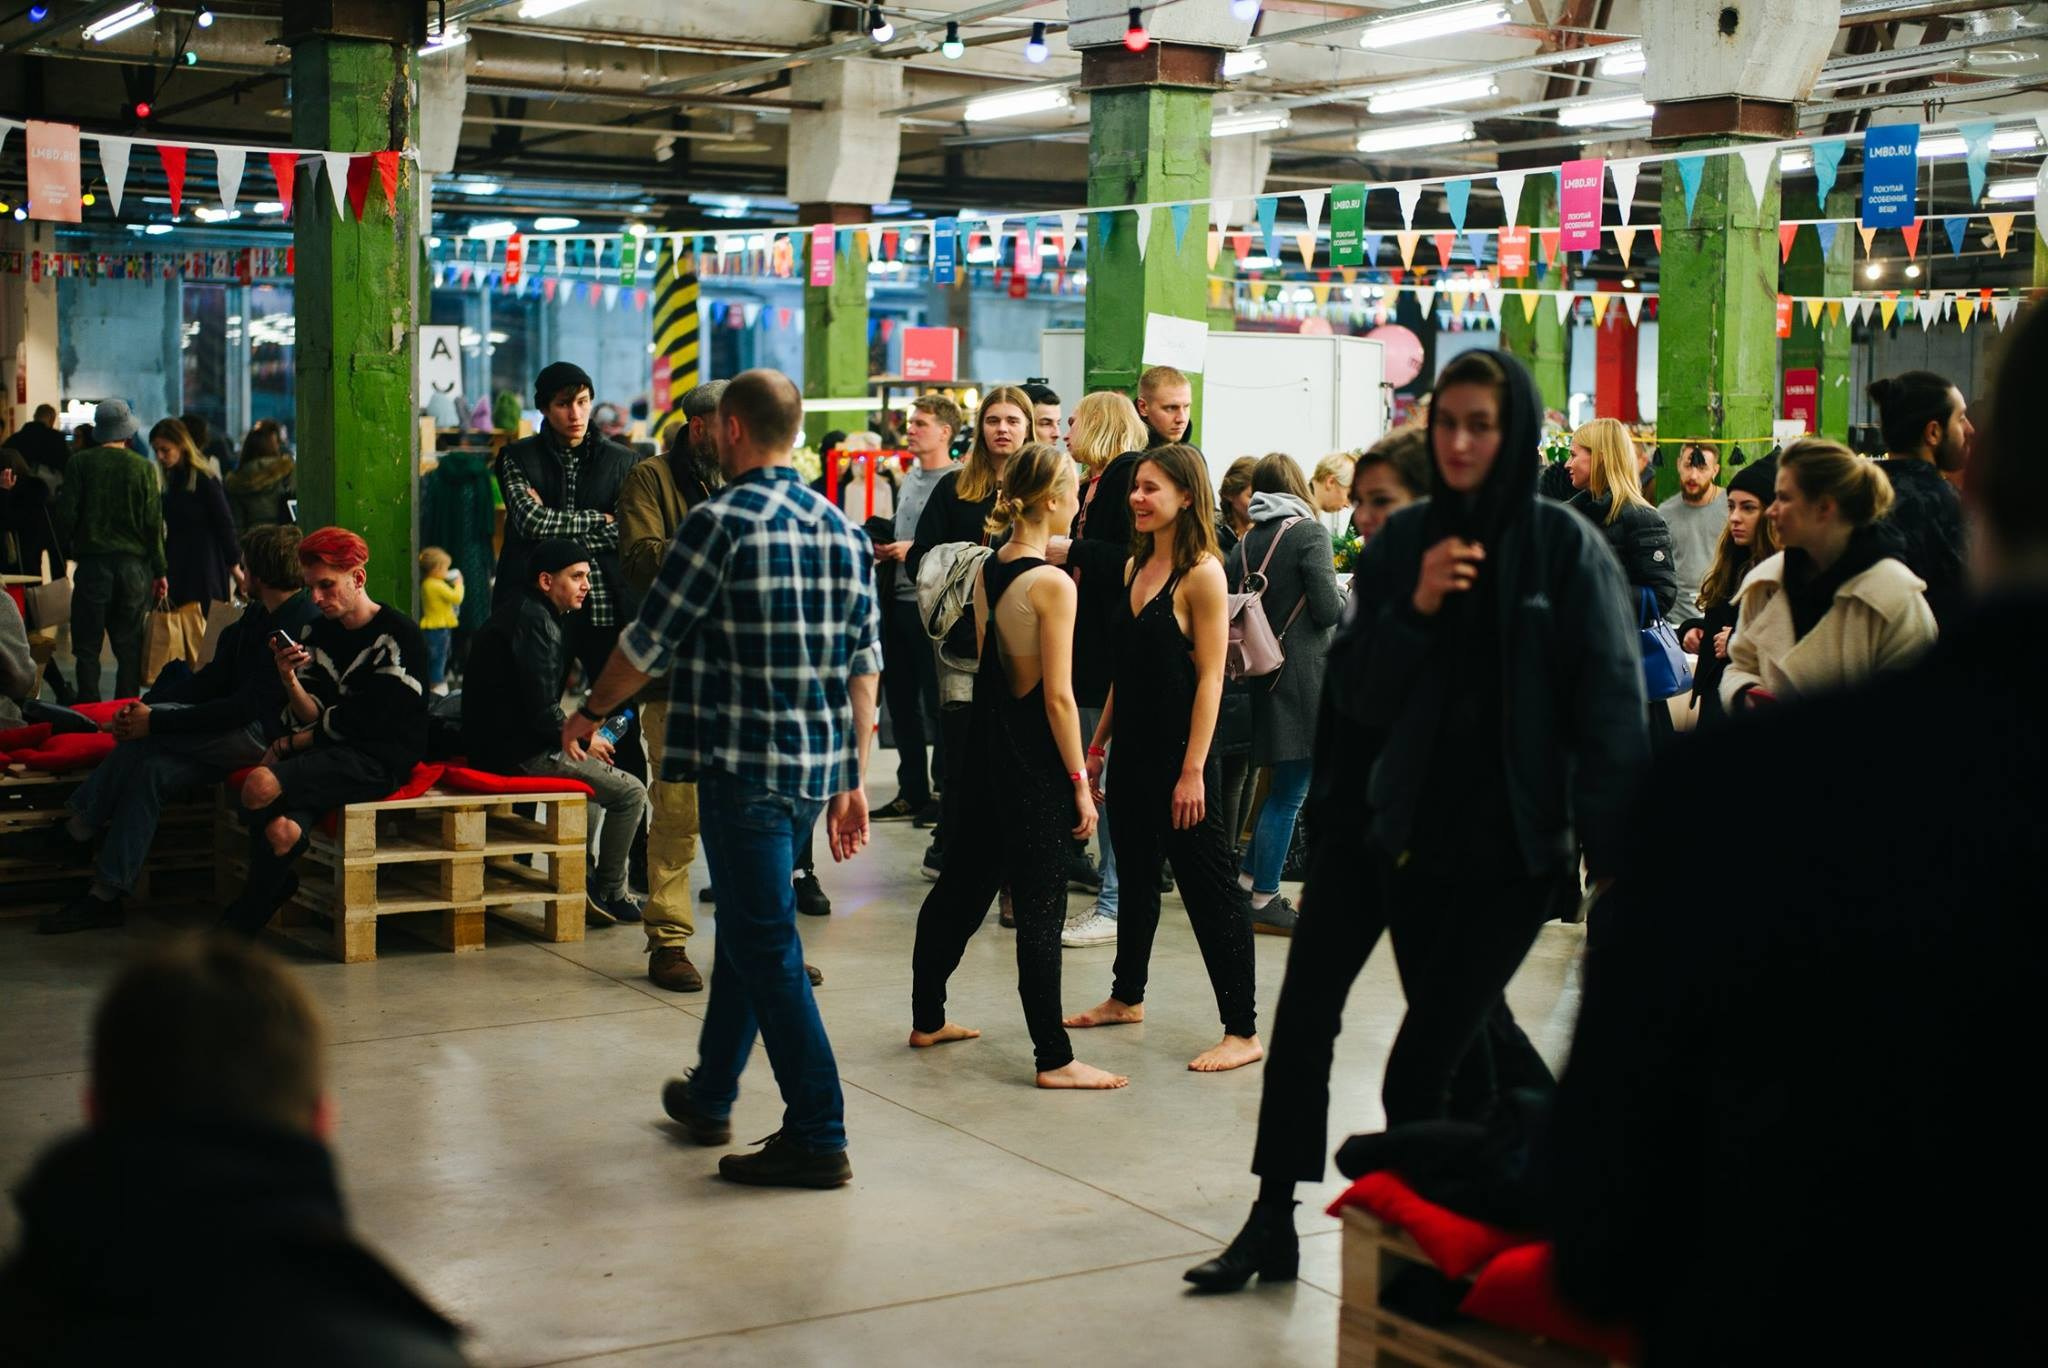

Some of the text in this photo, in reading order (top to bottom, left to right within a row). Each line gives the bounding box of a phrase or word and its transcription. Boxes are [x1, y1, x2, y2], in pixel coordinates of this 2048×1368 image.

[1869, 144, 1912, 158] LMBD.RU
[1564, 177, 1598, 189] LMBD.RU
[1873, 184, 1904, 193] ПОКУПАЙ
[1333, 199, 1361, 210] LMBD.RU
